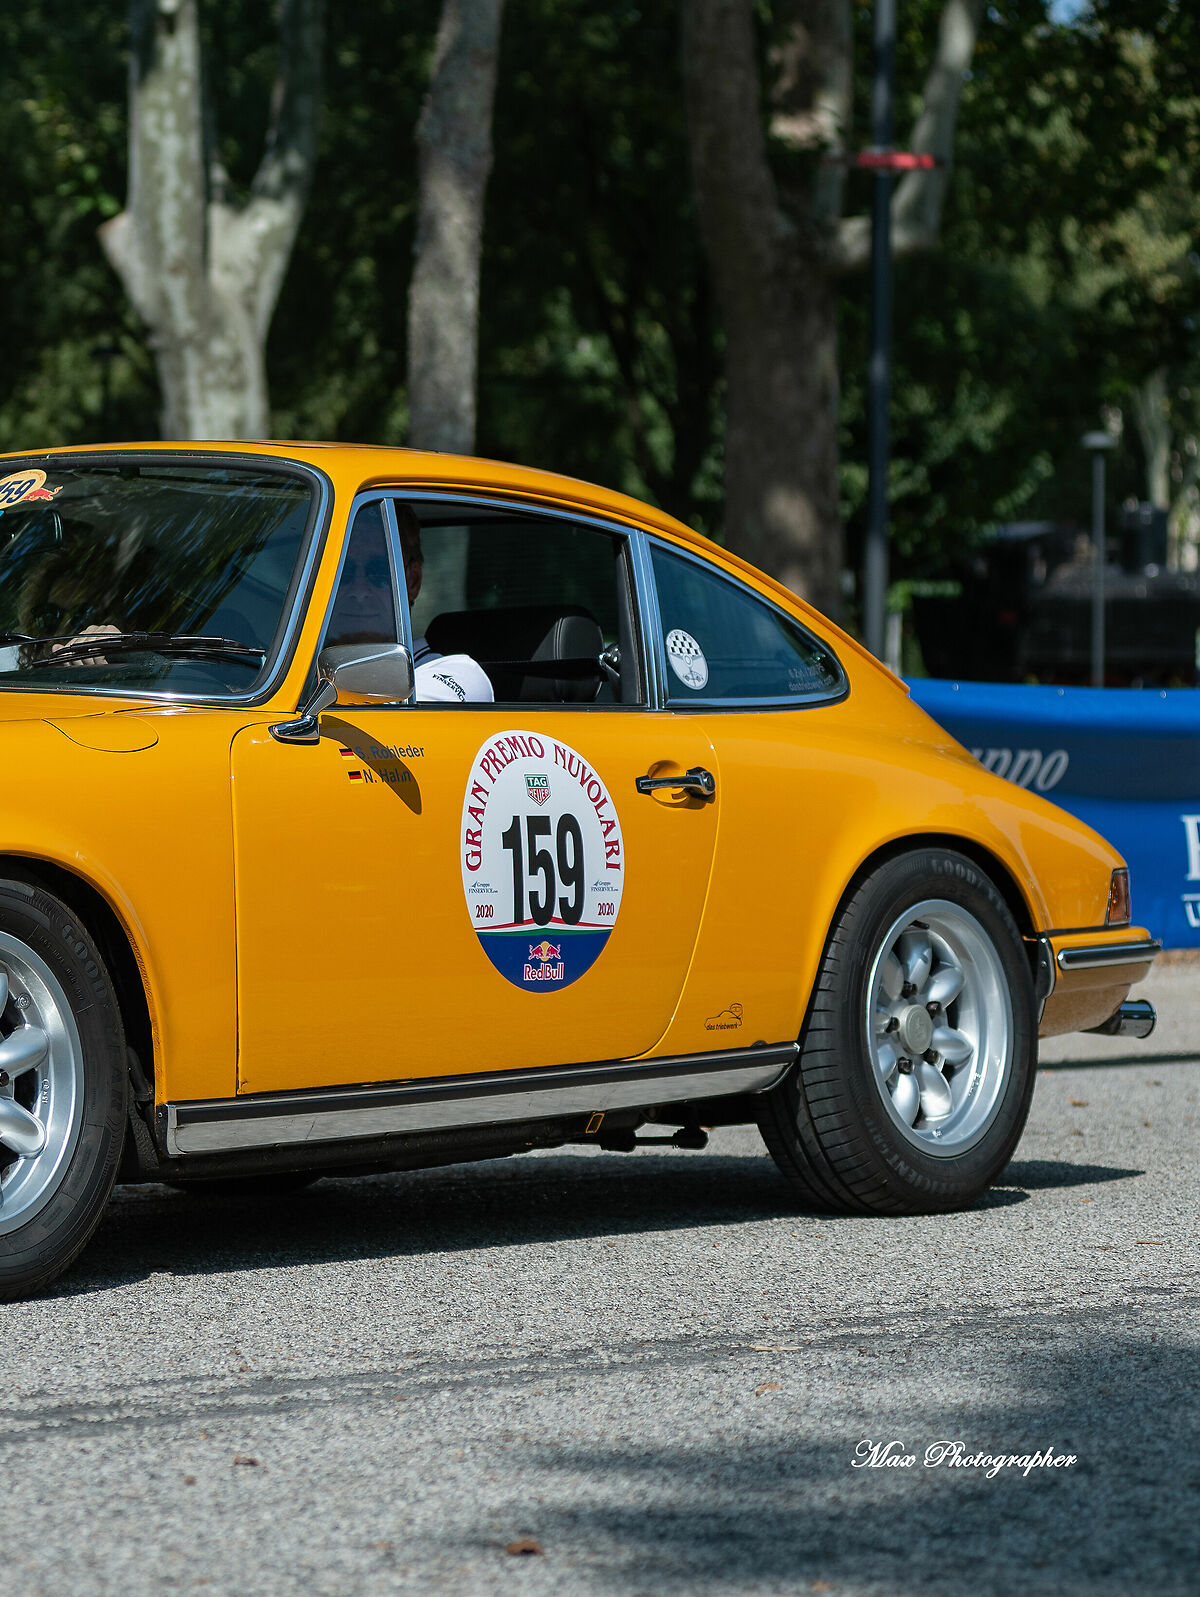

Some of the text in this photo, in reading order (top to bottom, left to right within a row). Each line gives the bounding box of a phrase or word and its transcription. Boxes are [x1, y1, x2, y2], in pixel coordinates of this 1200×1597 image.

[369, 744, 425, 760] Rohleder
[362, 768, 378, 784] N.
[527, 777, 547, 787] TAG
[465, 735, 622, 873] GRAN PREMIO NUVOLARI
[502, 813, 585, 927] 159
[475, 904, 494, 918] 2020
[597, 902, 615, 916] 2020
